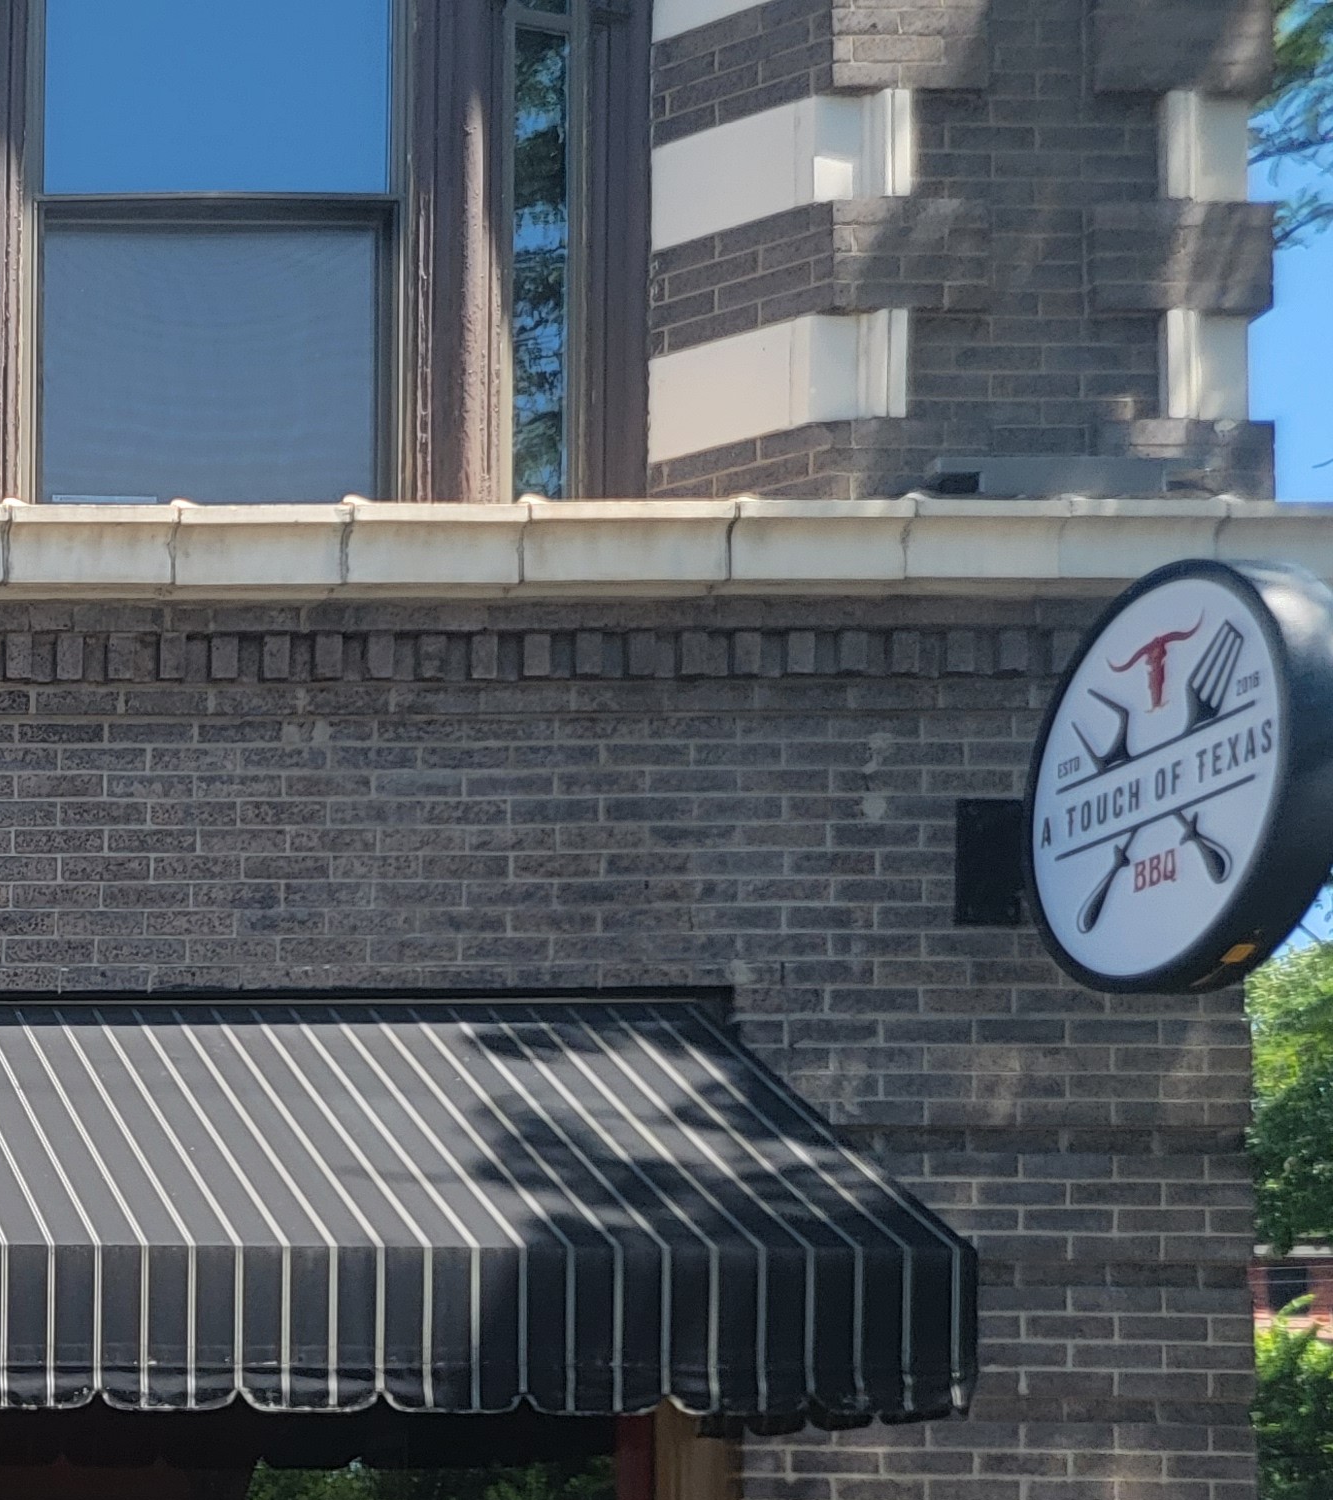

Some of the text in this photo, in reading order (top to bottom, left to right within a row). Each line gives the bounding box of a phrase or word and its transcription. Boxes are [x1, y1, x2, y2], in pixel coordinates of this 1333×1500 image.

[1041, 719, 1272, 848] A TOUCH OF TEXAS
[1057, 756, 1080, 779] ESTD
[1134, 848, 1177, 892] BBQ
